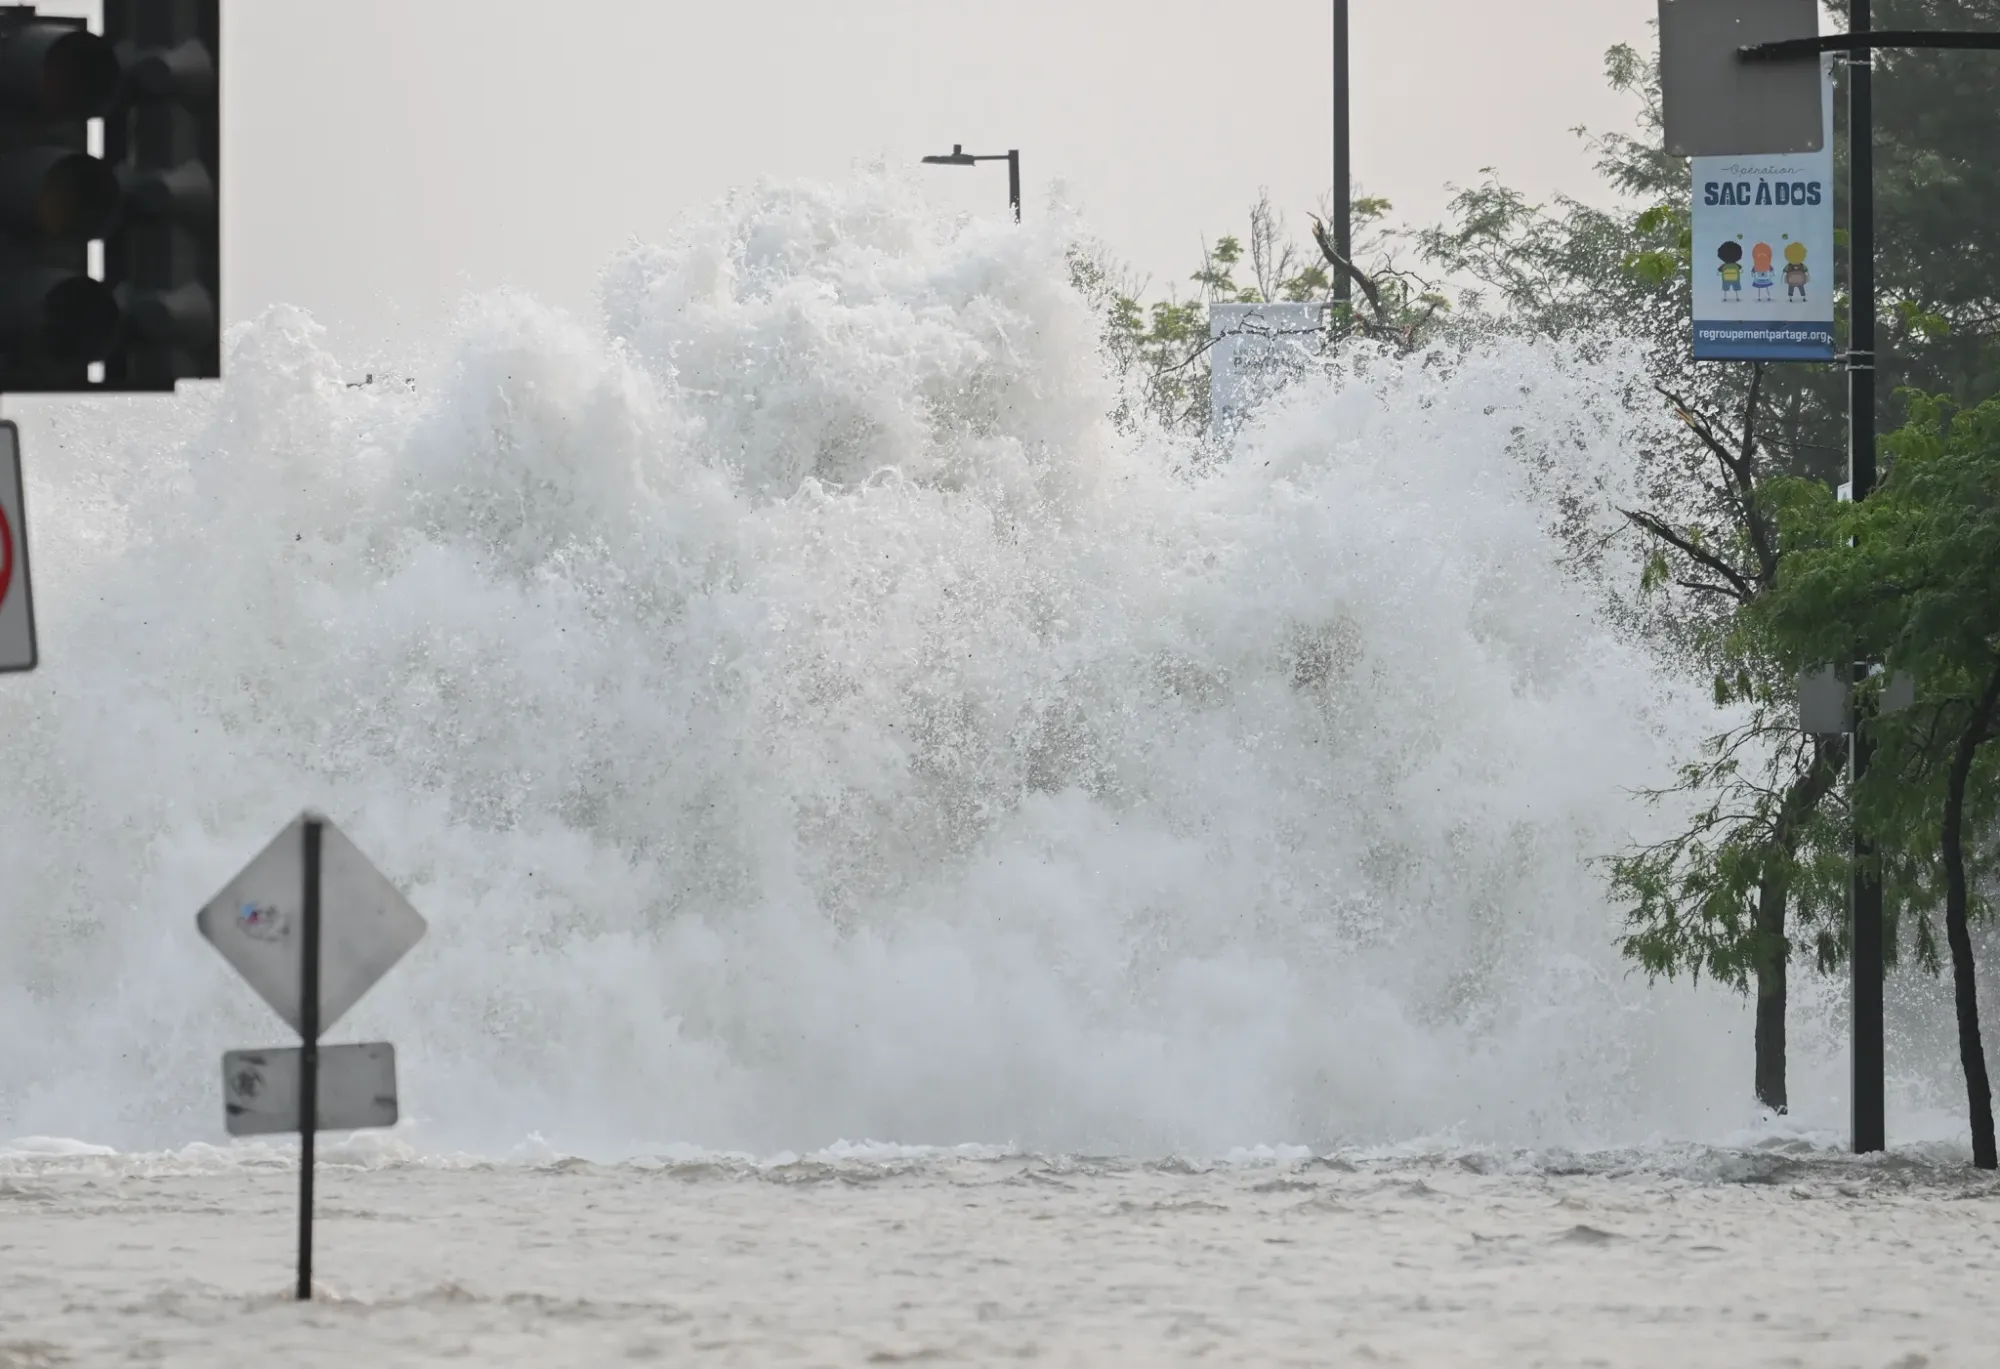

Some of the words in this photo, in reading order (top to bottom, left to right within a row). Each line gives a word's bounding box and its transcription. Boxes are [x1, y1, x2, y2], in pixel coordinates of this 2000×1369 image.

[1704, 182, 1750, 205] SAC
[1755, 178, 1773, 205] À
[1775, 182, 1821, 205] DOS
[1699, 329, 1827, 342] regroupementpartage.org
